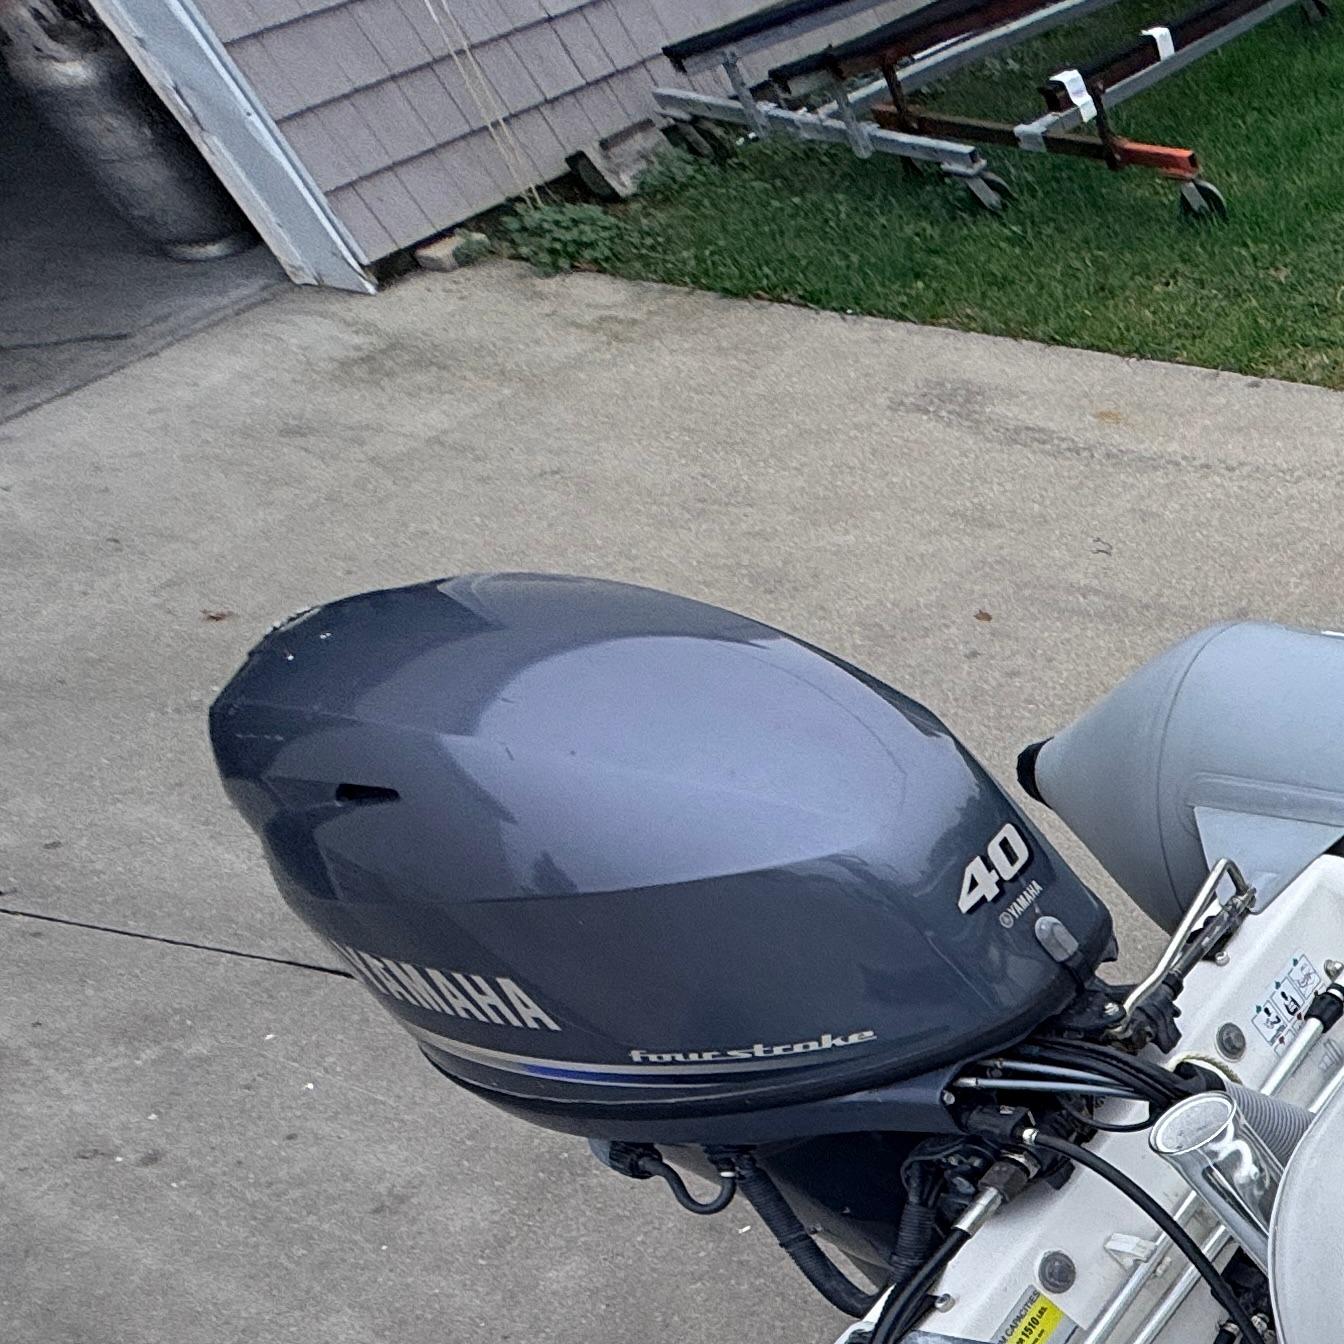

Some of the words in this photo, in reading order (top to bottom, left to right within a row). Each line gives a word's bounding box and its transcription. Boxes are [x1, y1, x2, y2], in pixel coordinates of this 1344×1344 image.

[958, 823, 1030, 914] 40
[1006, 880, 1043, 919] YAMAHA
[327, 937, 563, 1032] YAMAHA
[1005, 1290, 1041, 1337] CAPACITIES
[1021, 1316, 1041, 1340] 1510
